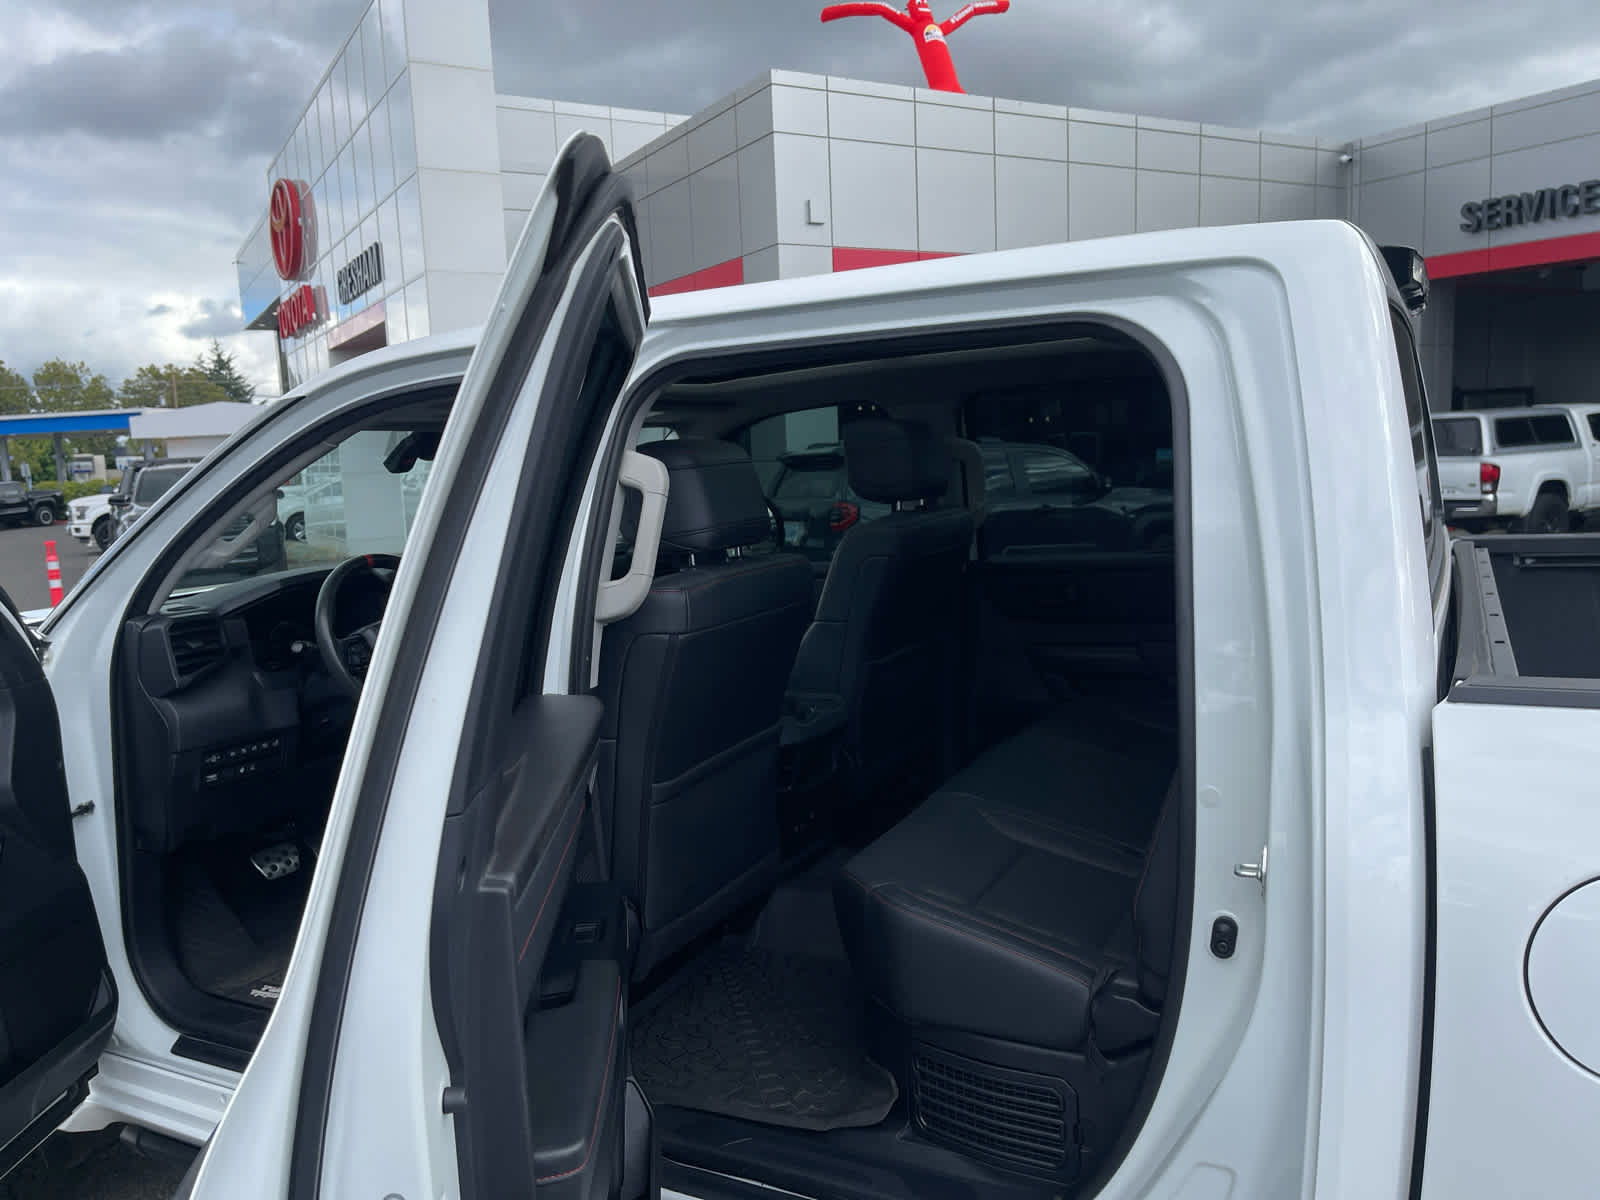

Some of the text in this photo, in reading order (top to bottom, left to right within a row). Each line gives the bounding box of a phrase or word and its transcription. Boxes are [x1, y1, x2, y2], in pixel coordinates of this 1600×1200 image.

[1460, 179, 1600, 232] SERVICE
[337, 241, 382, 305] GRESHAM
[277, 285, 316, 339] TOYOTA
